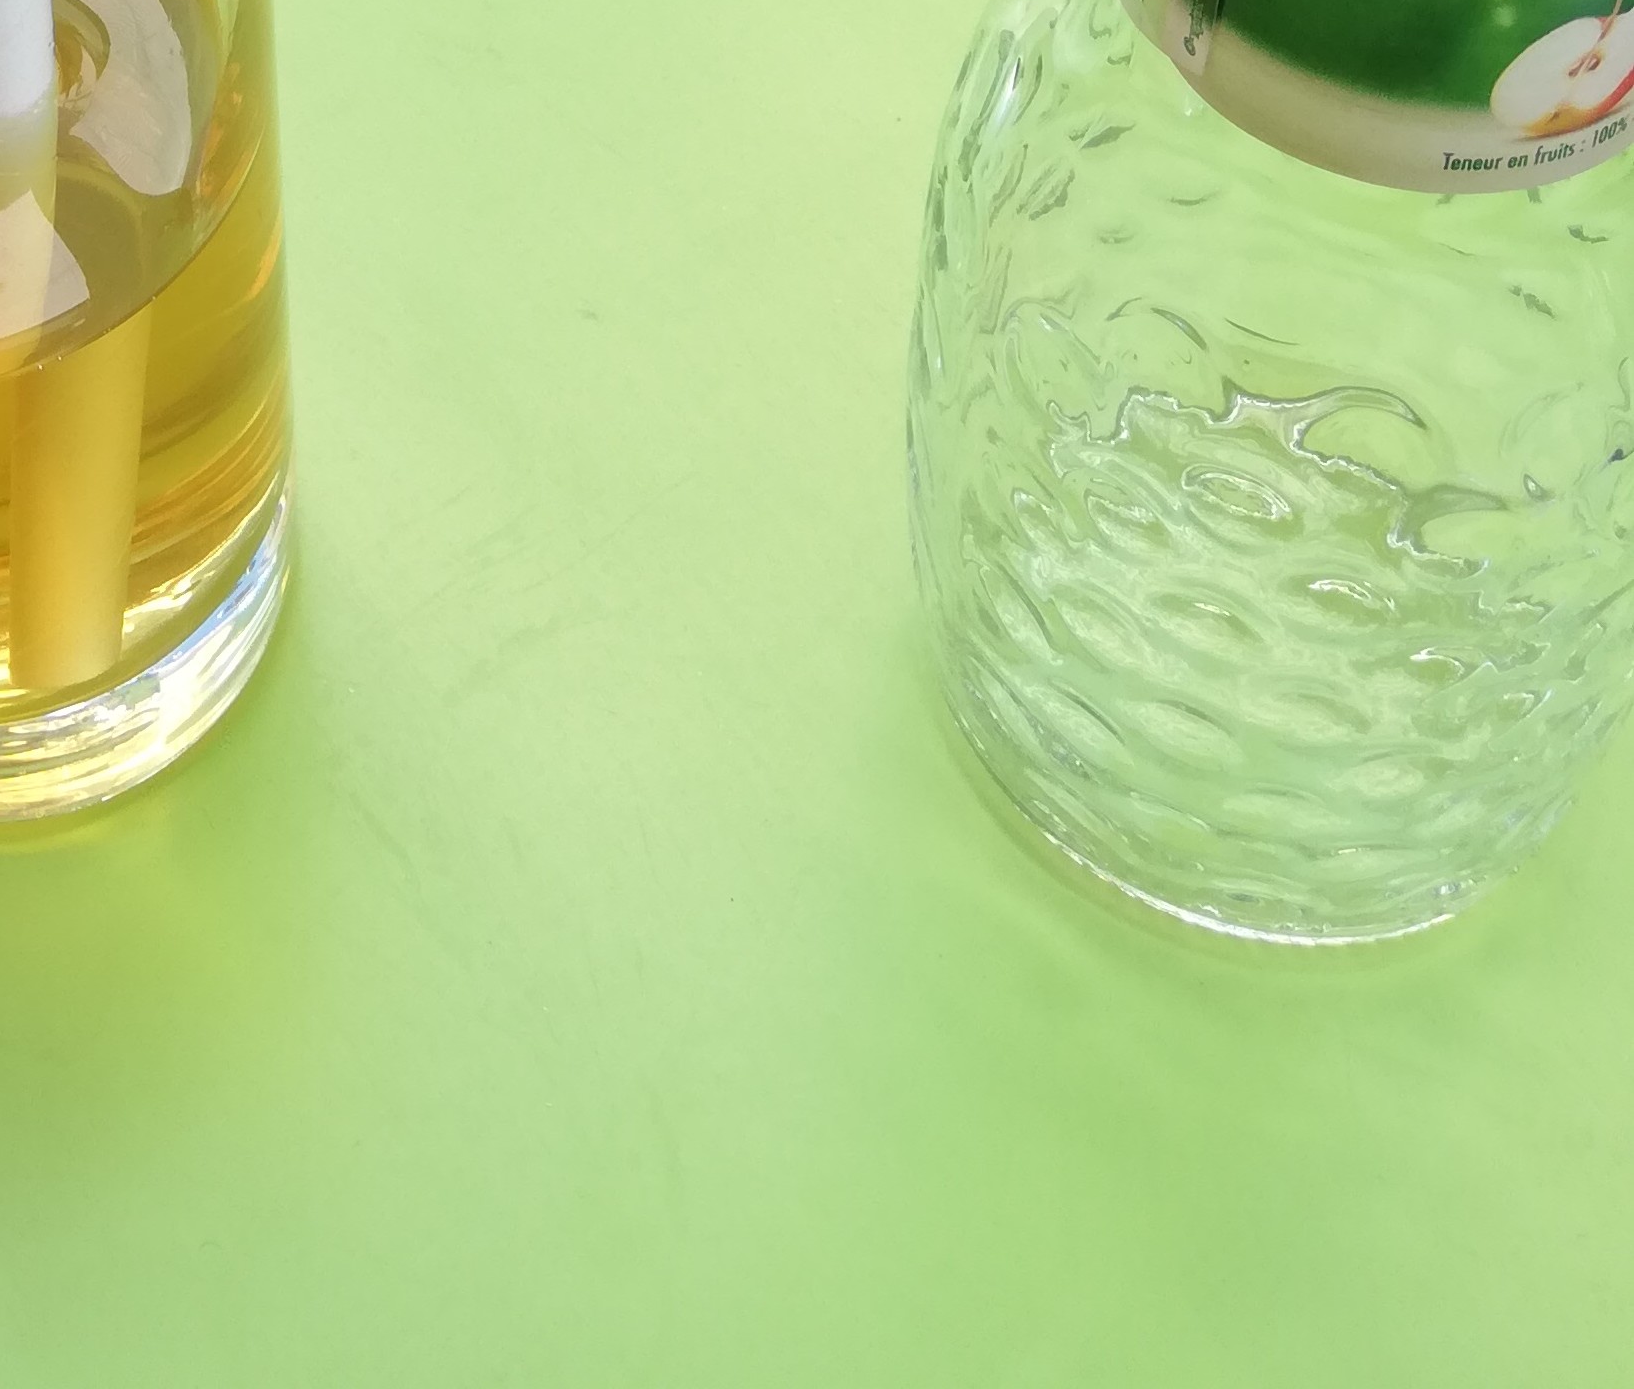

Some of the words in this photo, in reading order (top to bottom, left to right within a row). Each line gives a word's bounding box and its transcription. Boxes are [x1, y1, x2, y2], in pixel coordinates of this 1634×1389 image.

[1443, 152, 1503, 172] Teneur
[1507, 154, 1528, 169] en
[1534, 143, 1575, 166] fruits
[1592, 116, 1628, 148] 100%
